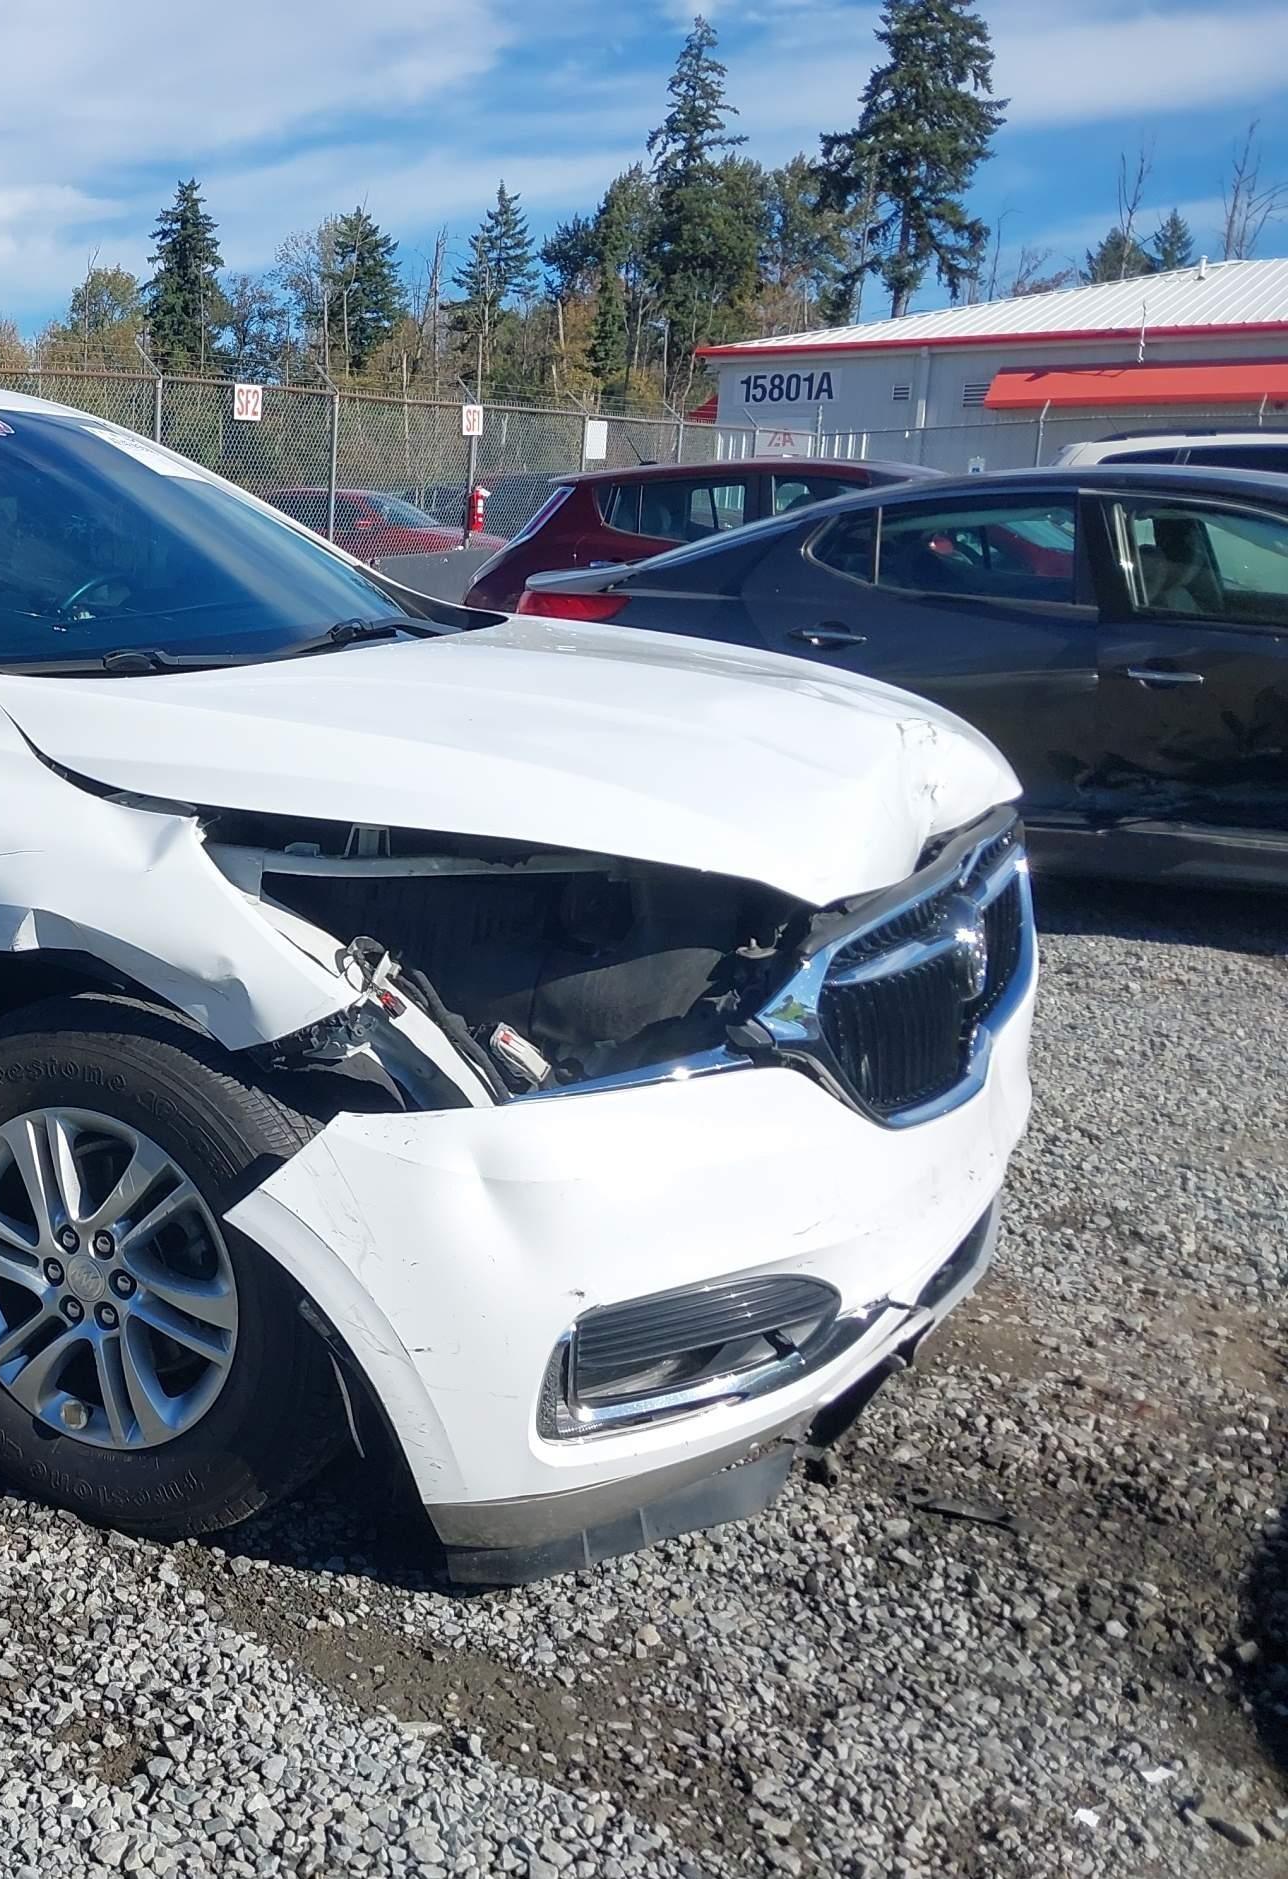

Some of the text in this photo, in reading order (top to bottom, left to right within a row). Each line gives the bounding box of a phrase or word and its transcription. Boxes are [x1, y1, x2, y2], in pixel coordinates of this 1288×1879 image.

[740, 371, 834, 403] 15801A
[237, 388, 260, 417] SF2
[466, 409, 480, 432] SF1
